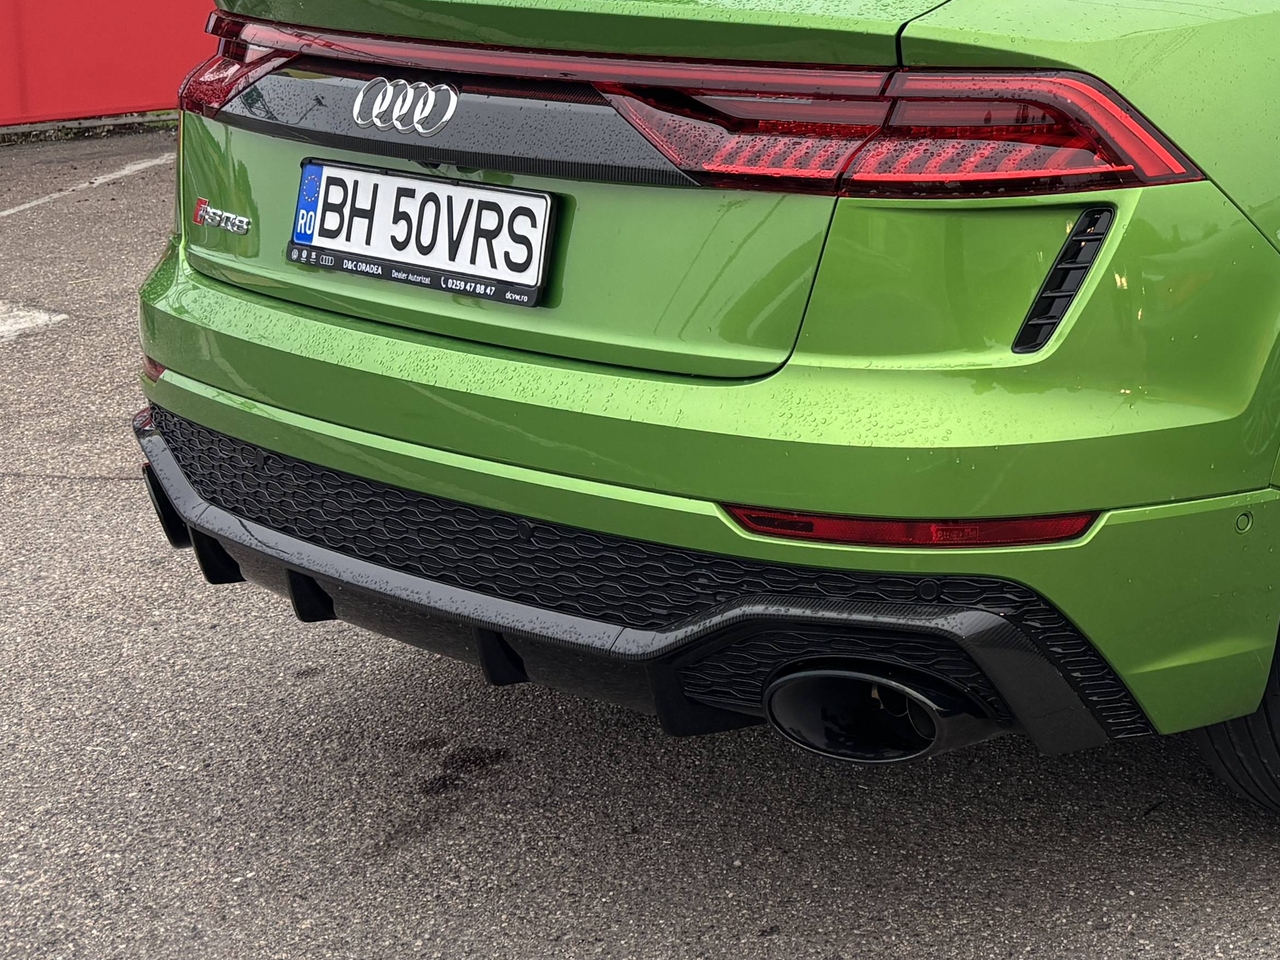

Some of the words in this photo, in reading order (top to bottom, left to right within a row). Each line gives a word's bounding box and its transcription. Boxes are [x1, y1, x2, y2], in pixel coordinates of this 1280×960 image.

[318, 176, 379, 246] BH
[297, 209, 315, 235] RO
[342, 259, 357, 272] D&C
[356, 263, 383, 276] ORADEA
[391, 269, 407, 281] Dealer
[408, 271, 431, 285] Autorizat
[447, 278, 465, 291] 0259
[466, 281, 476, 292] 47
[475, 283, 485, 294] 88
[485, 284, 496, 296] 47
